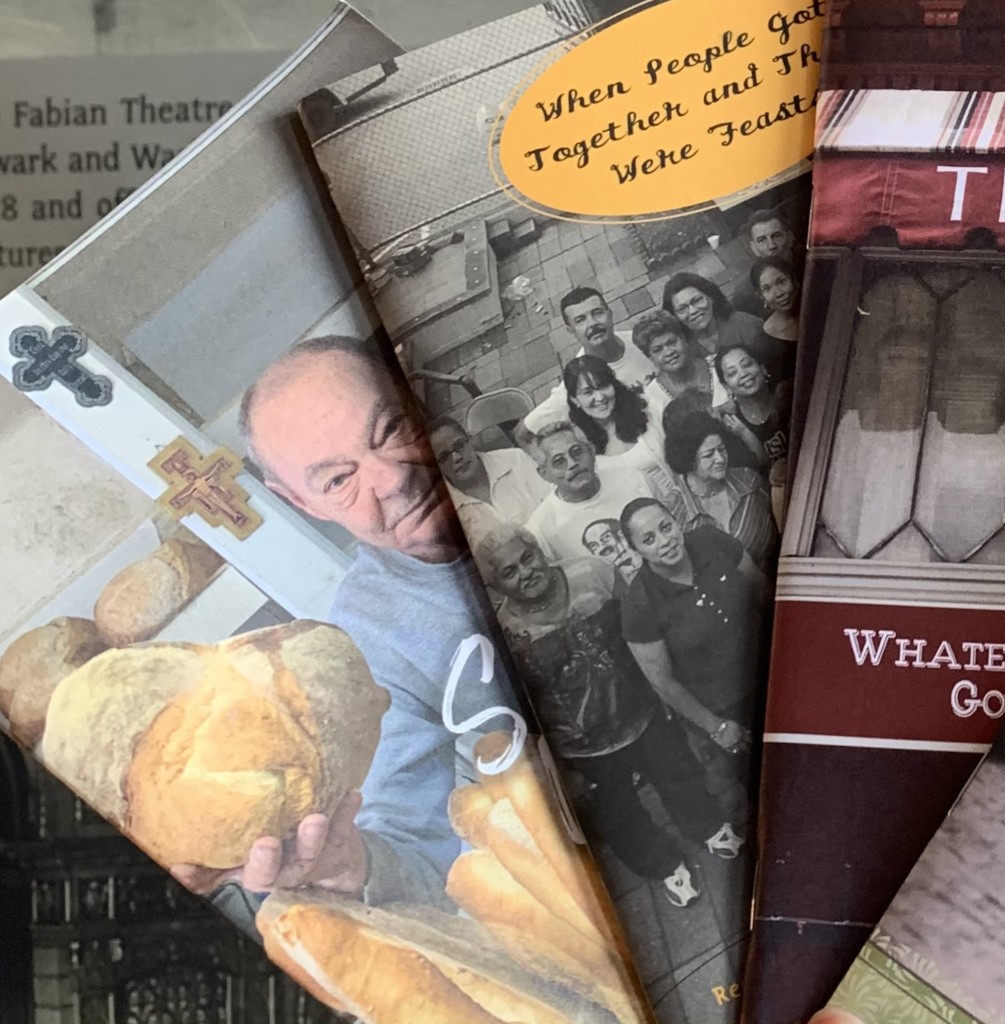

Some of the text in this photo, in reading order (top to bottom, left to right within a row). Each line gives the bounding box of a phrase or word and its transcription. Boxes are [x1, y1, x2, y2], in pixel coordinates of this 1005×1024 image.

[536, 80, 631, 122] When
[644, 31, 755, 85] People
[13, 93, 234, 129] Fabian Theatre
[524, 100, 689, 172] Together
[703, 63, 763, 106] and
[69, 140, 120, 173] and
[130, 142, 184, 170] Wa
[610, 142, 699, 185] Were
[2, 193, 18, 221] 8
[32, 188, 82, 221] and
[0, 243, 66, 267] ture
[442, 634, 527, 775] S
[711, 984, 741, 1006] Re
